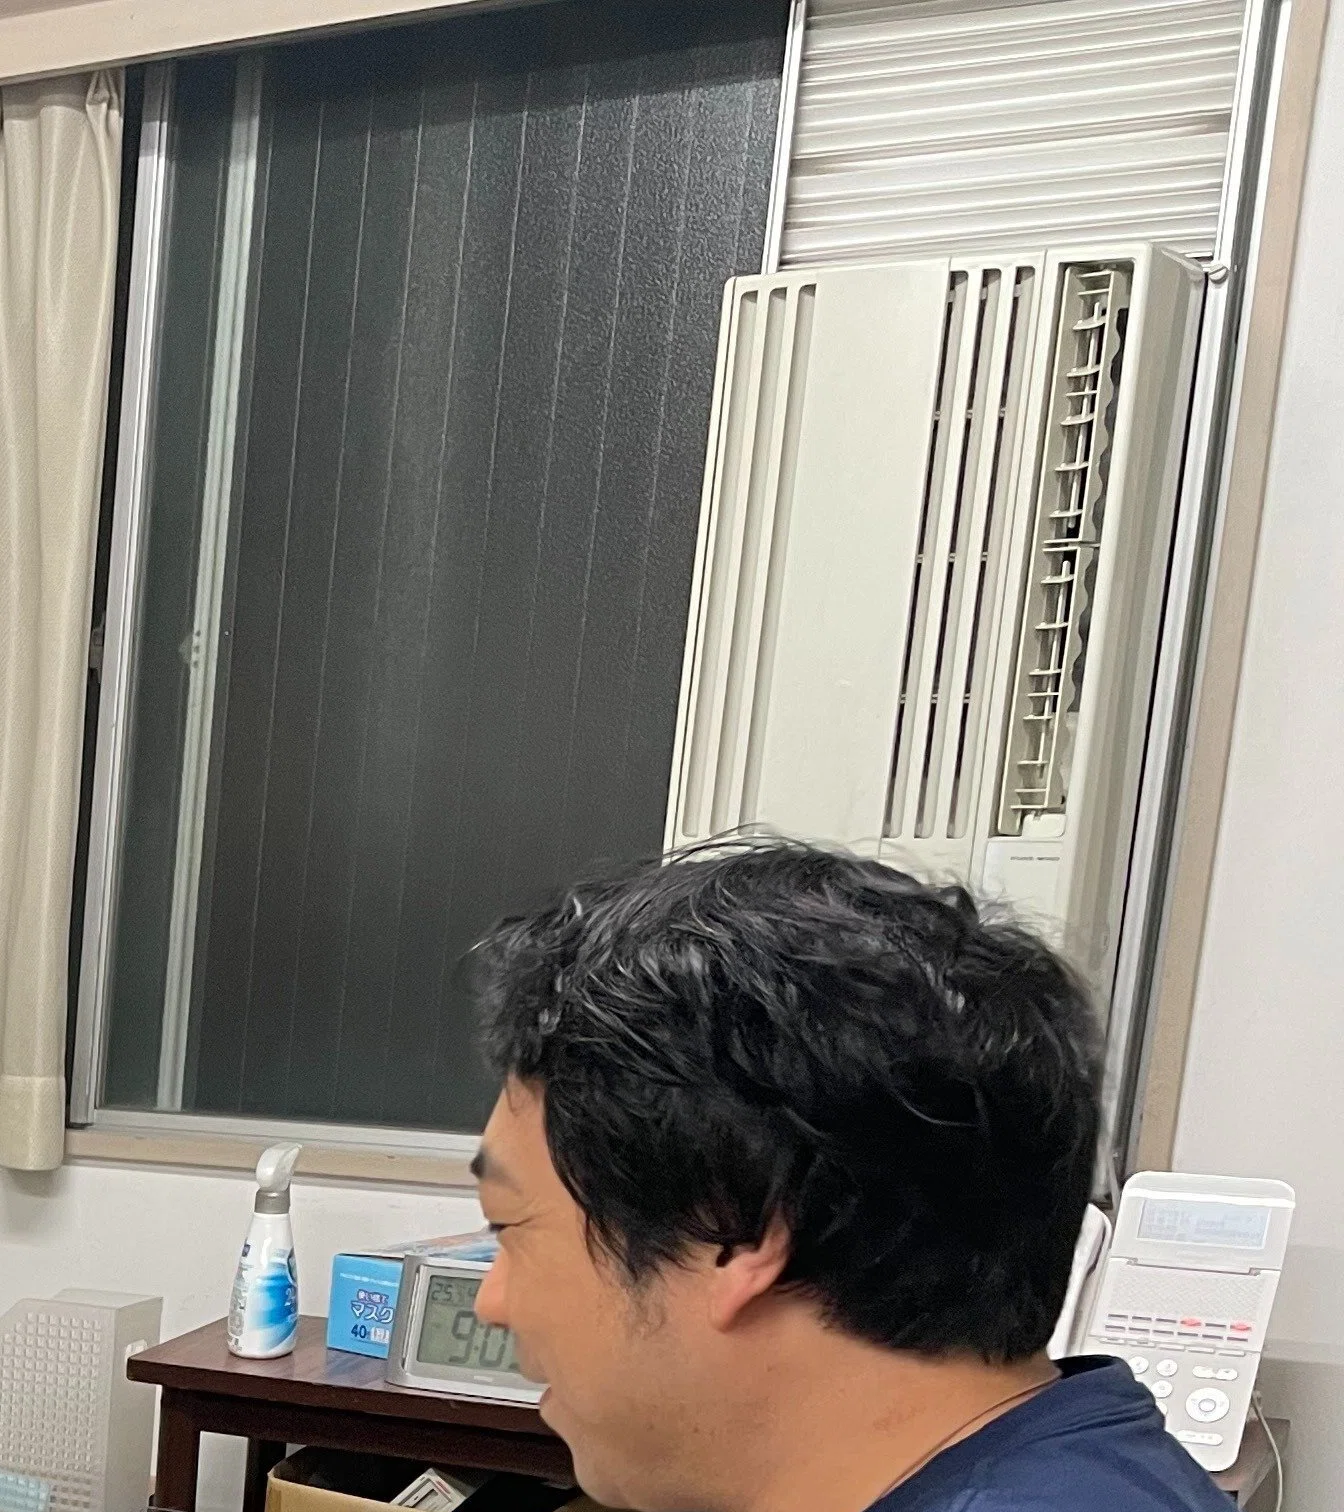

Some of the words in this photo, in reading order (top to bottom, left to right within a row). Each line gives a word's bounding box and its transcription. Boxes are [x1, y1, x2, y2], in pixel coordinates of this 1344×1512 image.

[350, 1301, 394, 1324] マスク
[350, 1323, 368, 1339] 40
